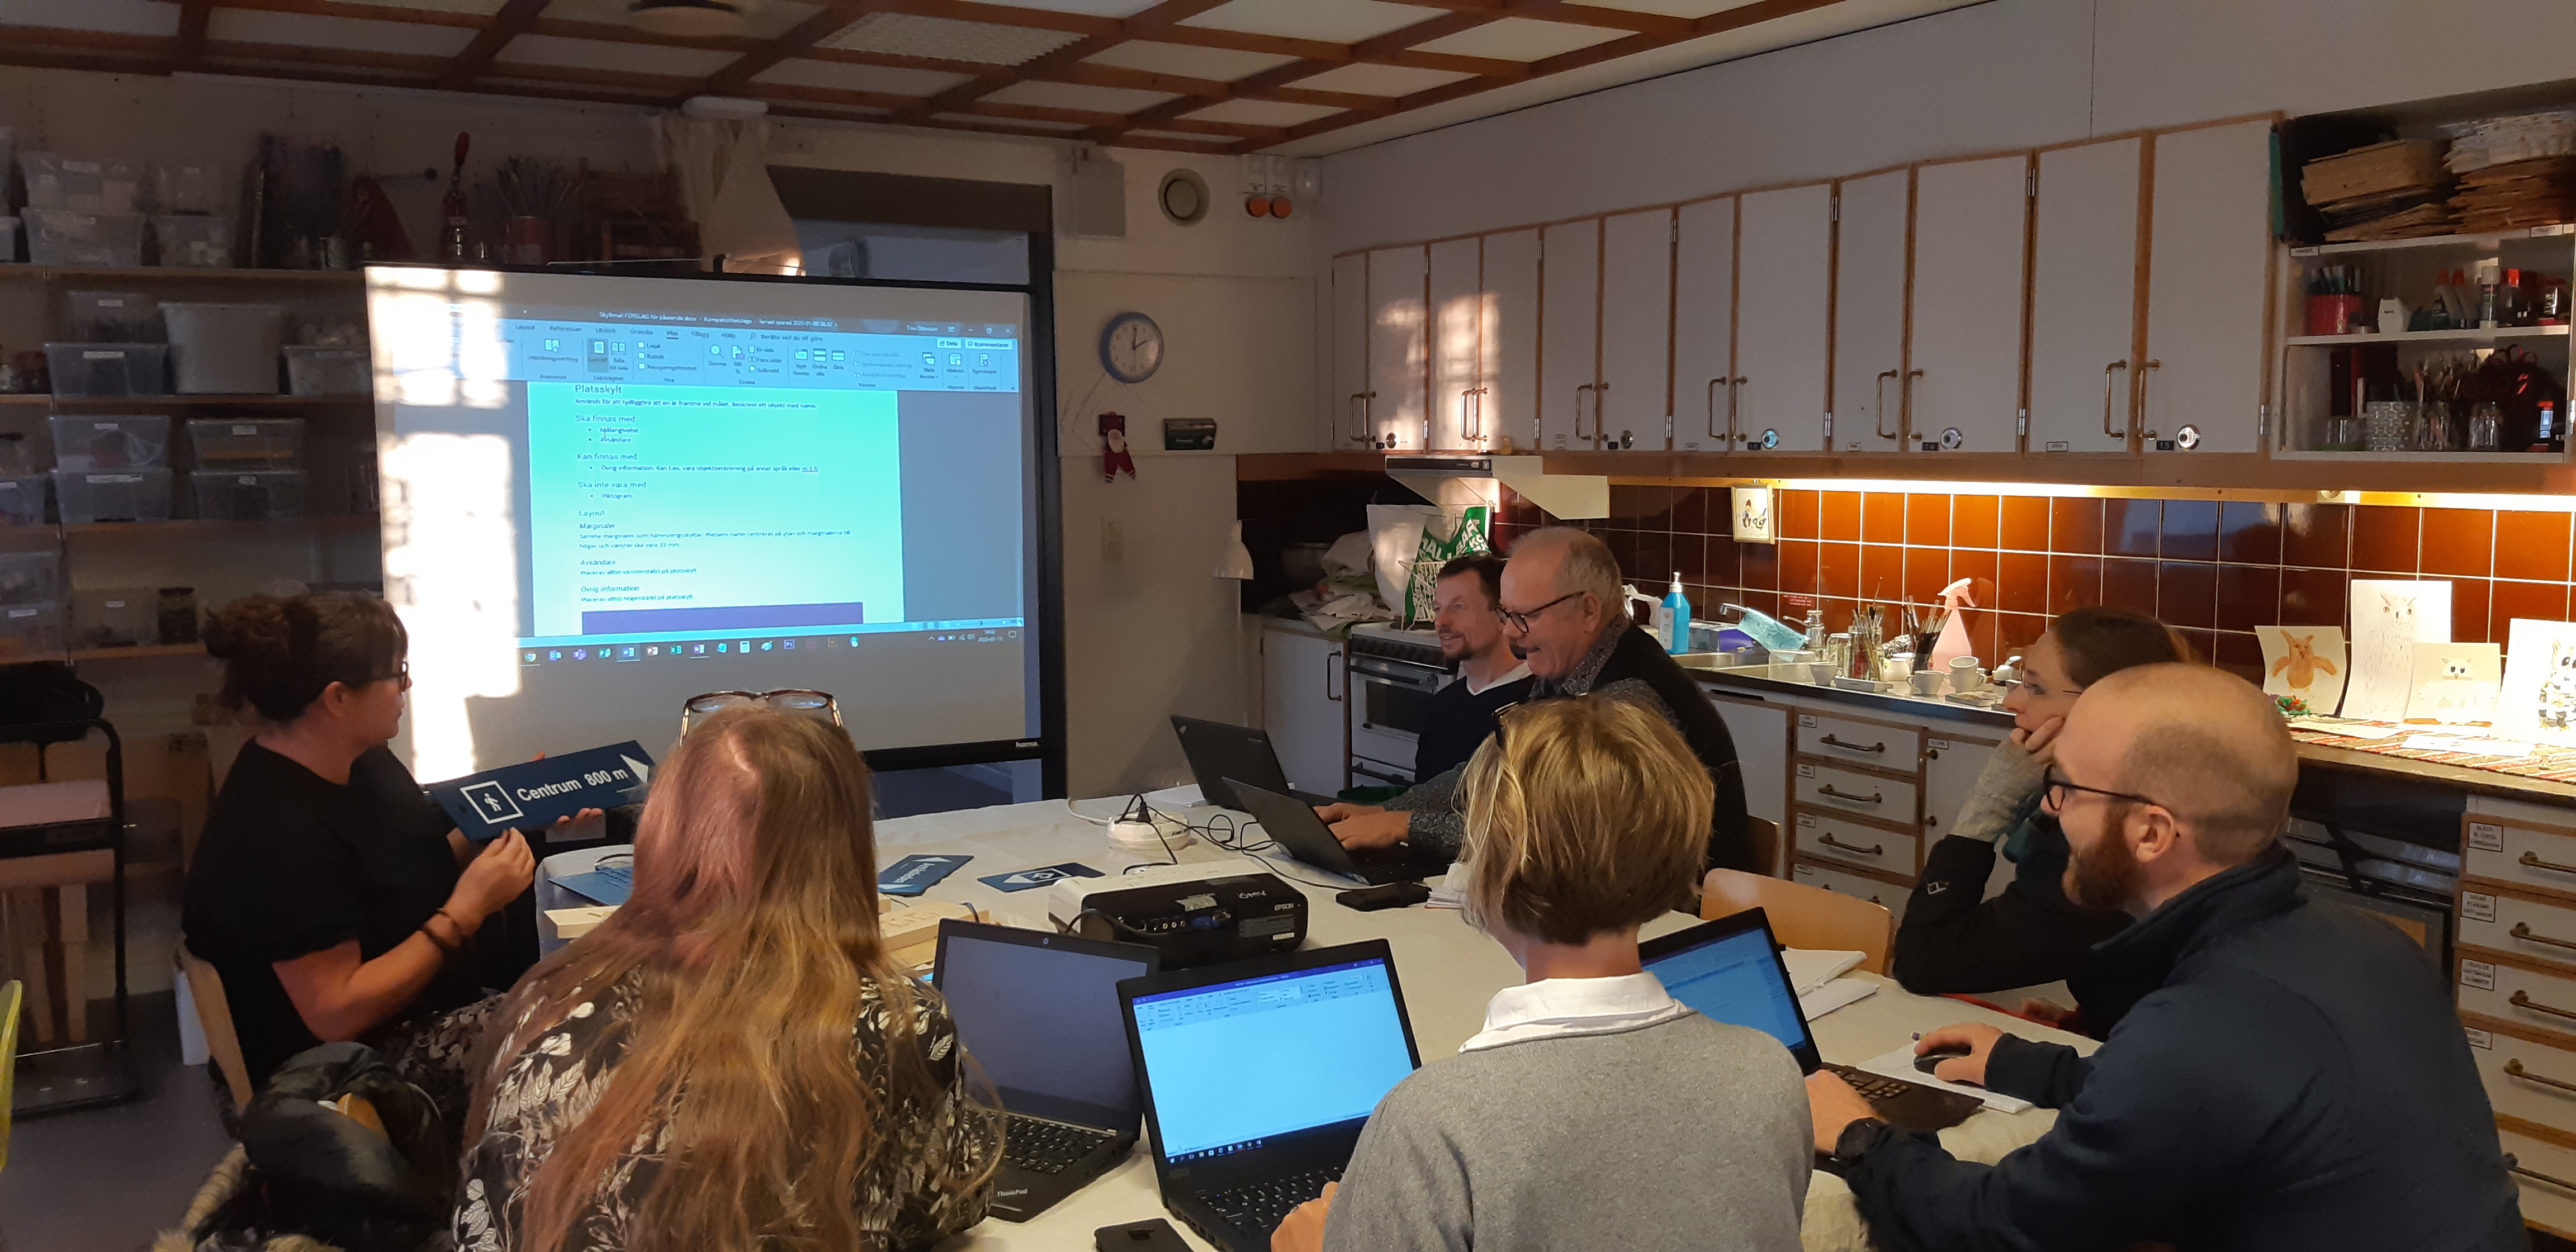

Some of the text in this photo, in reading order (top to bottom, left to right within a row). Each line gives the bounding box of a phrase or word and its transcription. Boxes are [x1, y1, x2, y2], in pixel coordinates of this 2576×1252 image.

[575, 385, 622, 395] Platsskylt
[517, 767, 629, 802] Centrum 800 m
[1275, 903, 1294, 911] EPSON
[997, 1188, 1028, 1197] ThinkPad
